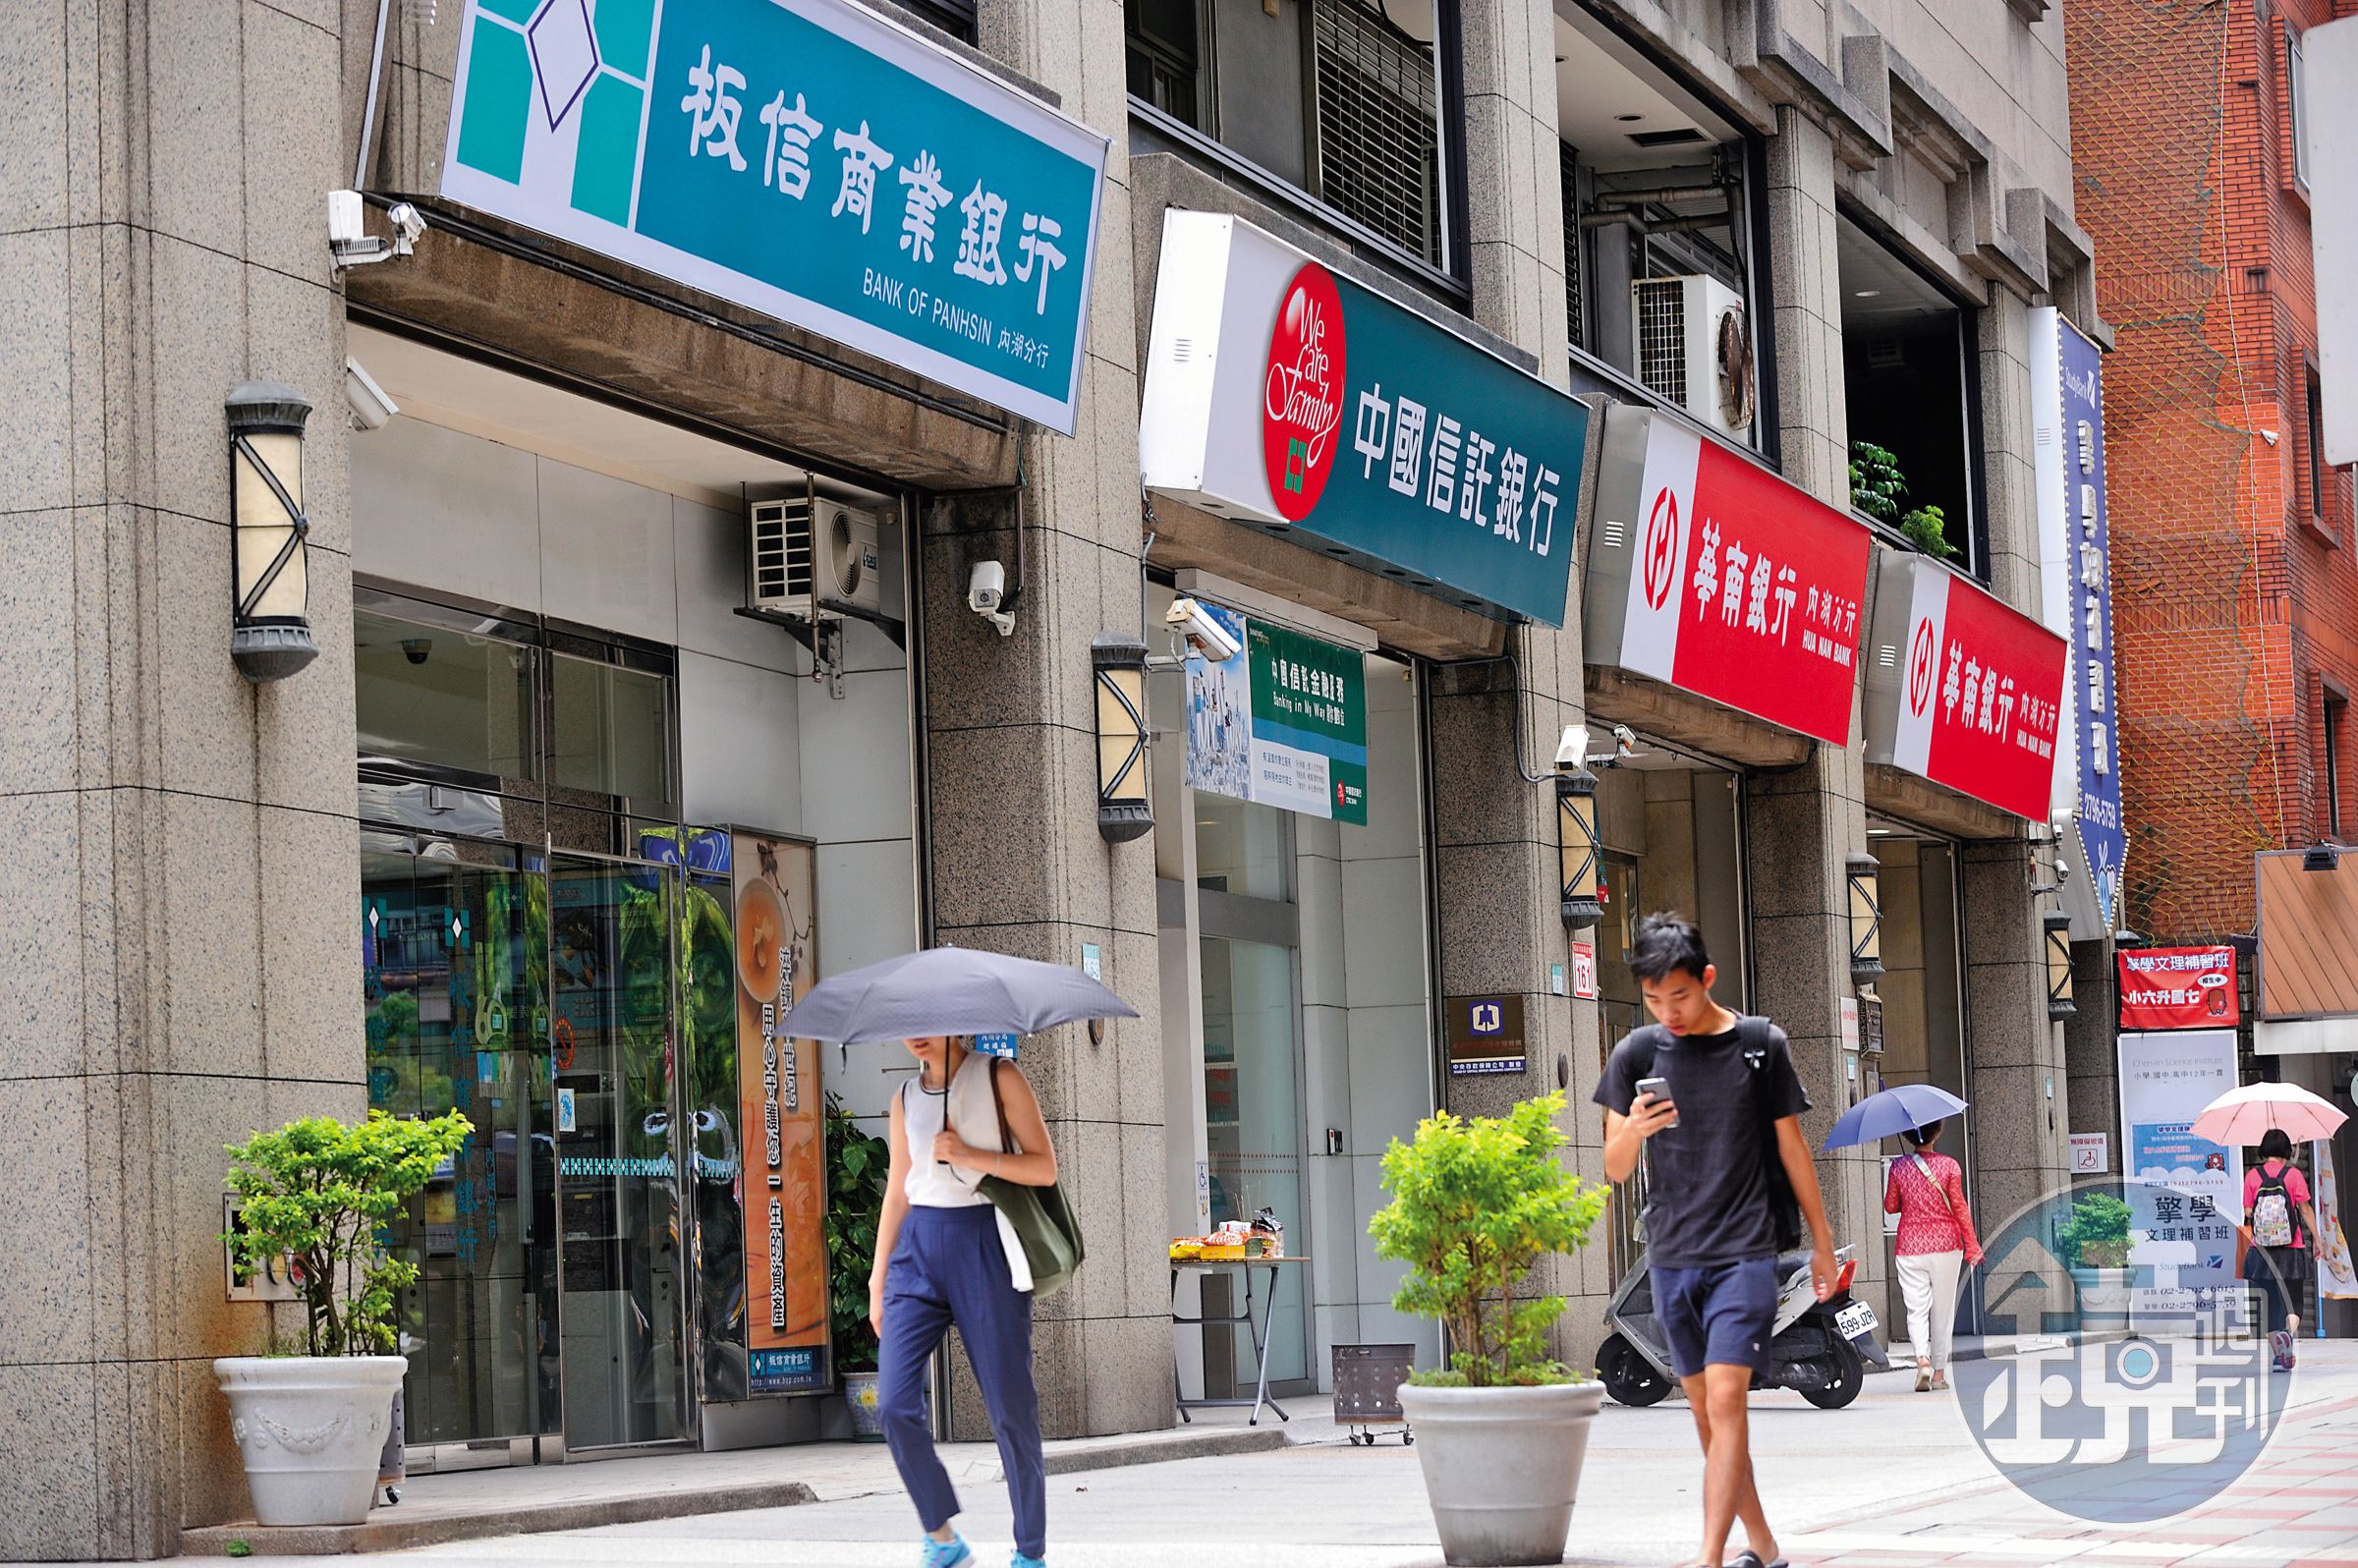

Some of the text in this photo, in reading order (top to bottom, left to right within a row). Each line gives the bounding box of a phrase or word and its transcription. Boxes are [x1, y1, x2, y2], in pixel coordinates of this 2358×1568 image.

[681, 44, 1067, 315] 板信商業銀行
[863, 267, 992, 346] BANK OF PANHSIN
[1299, 295, 1325, 353] We
[997, 327, 1049, 368] 內湖分行
[1305, 349, 1329, 386] are
[1354, 382, 1560, 557] 中國信託銀行
[1693, 517, 1796, 647] 華南銀行
[1806, 583, 1856, 638] 內湖分行
[1802, 629, 1851, 667] HUA NAN BANK
[1273, 691, 1292, 713] Banking
[1295, 698, 1302, 712] in
[1314, 701, 1325, 720] Way
[1942, 639, 2014, 744] 華南銀行
[2020, 691, 2055, 735] 內湖分行
[2084, 793, 2115, 829] 2796-5759
[1576, 964, 1592, 989] 161
[2129, 989, 2200, 1005] 小六升國七
[2155, 1195, 2217, 1224] 擎學
[2146, 1225, 2229, 1242] 文理補習班
